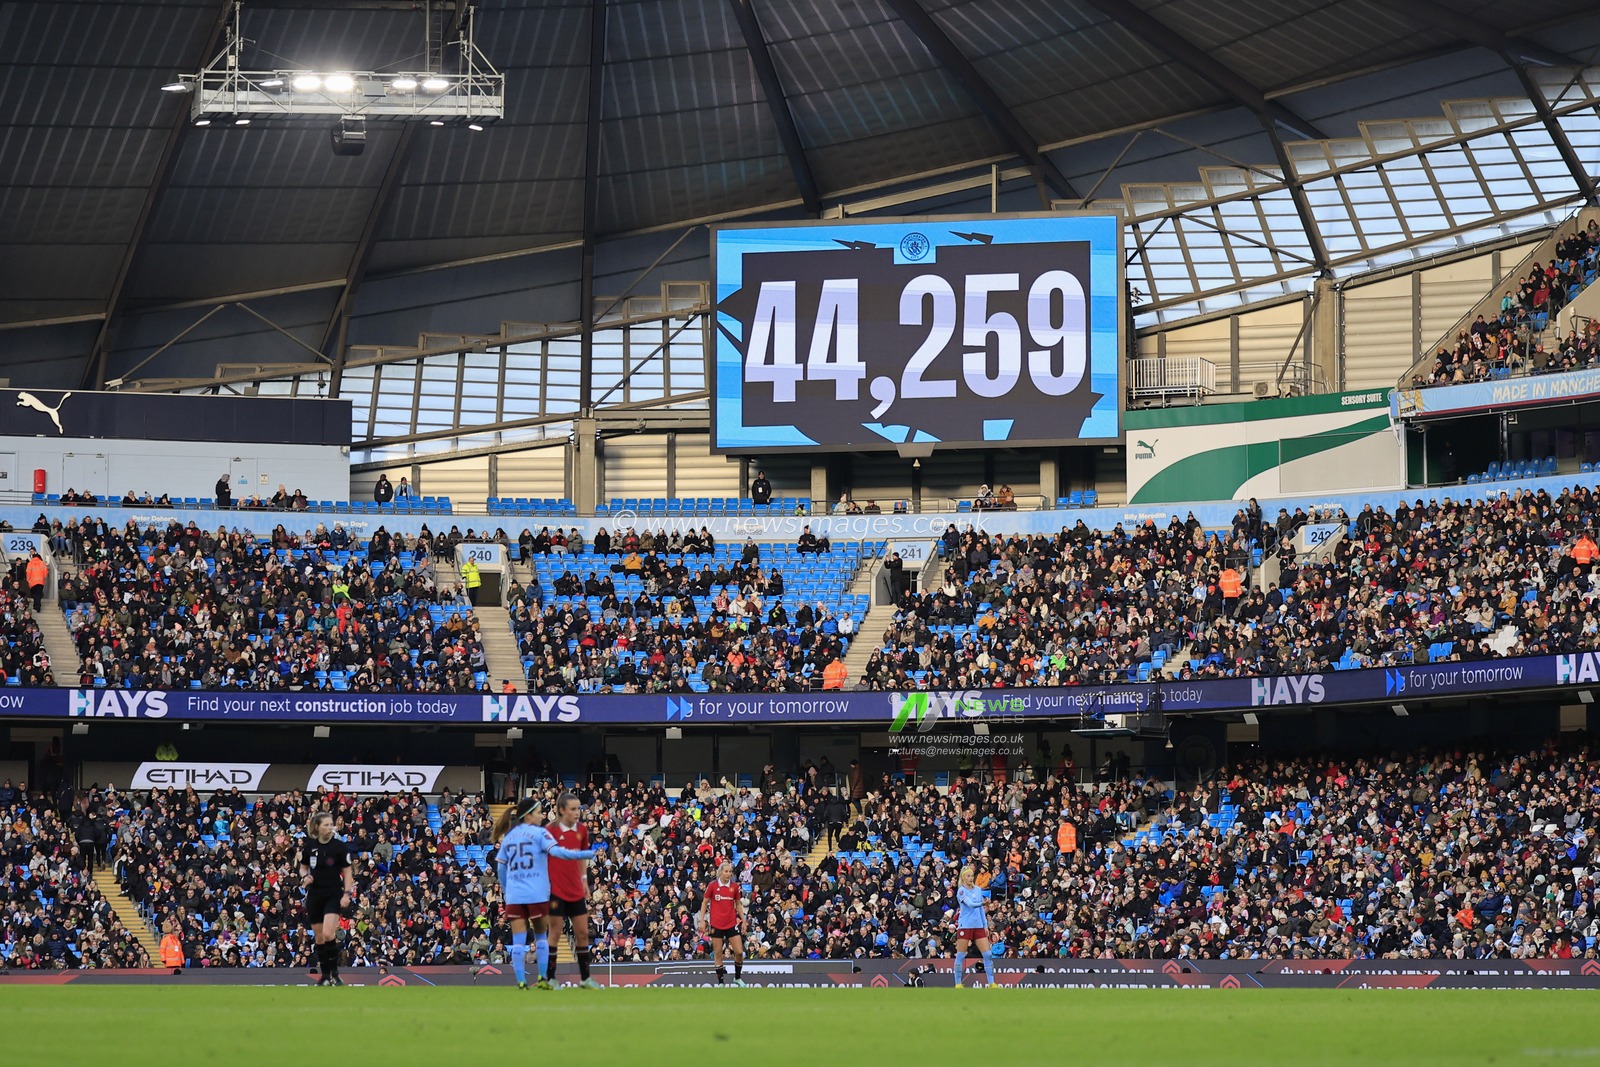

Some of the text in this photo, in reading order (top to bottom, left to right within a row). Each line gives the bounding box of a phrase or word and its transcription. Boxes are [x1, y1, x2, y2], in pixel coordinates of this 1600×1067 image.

[745, 269, 1087, 420] 44,259
[1341, 393, 1383, 406] SENSORY SUITE
[1492, 384, 1528, 403] MADE
[1532, 382, 1547, 398] IN
[1135, 452, 1153, 460] PUMA
[10, 540, 34, 551] 239
[1311, 530, 1331, 543] 242
[469, 550, 492, 561] 240
[901, 548, 922, 559] 241
[1410, 670, 1427, 688] for
[1430, 671, 1458, 690] your
[1461, 665, 1524, 683] tomorrow
[1002, 694, 1031, 708] Find
[1036, 695, 1064, 710] your
[1067, 692, 1094, 707] next
[1098, 690, 1144, 706] finance
[1170, 686, 1204, 704] today
[1251, 674, 1326, 706] HAYS
[68, 689, 169, 718] HAYS
[188, 697, 458, 716] Find your next construction job today
[481, 694, 581, 722] HAYS
[698, 698, 723, 715] for
[727, 701, 764, 718] your
[769, 700, 849, 715] tomorrow
[891, 690, 983, 719] HAYS
[146, 768, 252, 784] ETIHAD
[322, 770, 427, 786] ETIHAD
[506, 841, 534, 871] 25
